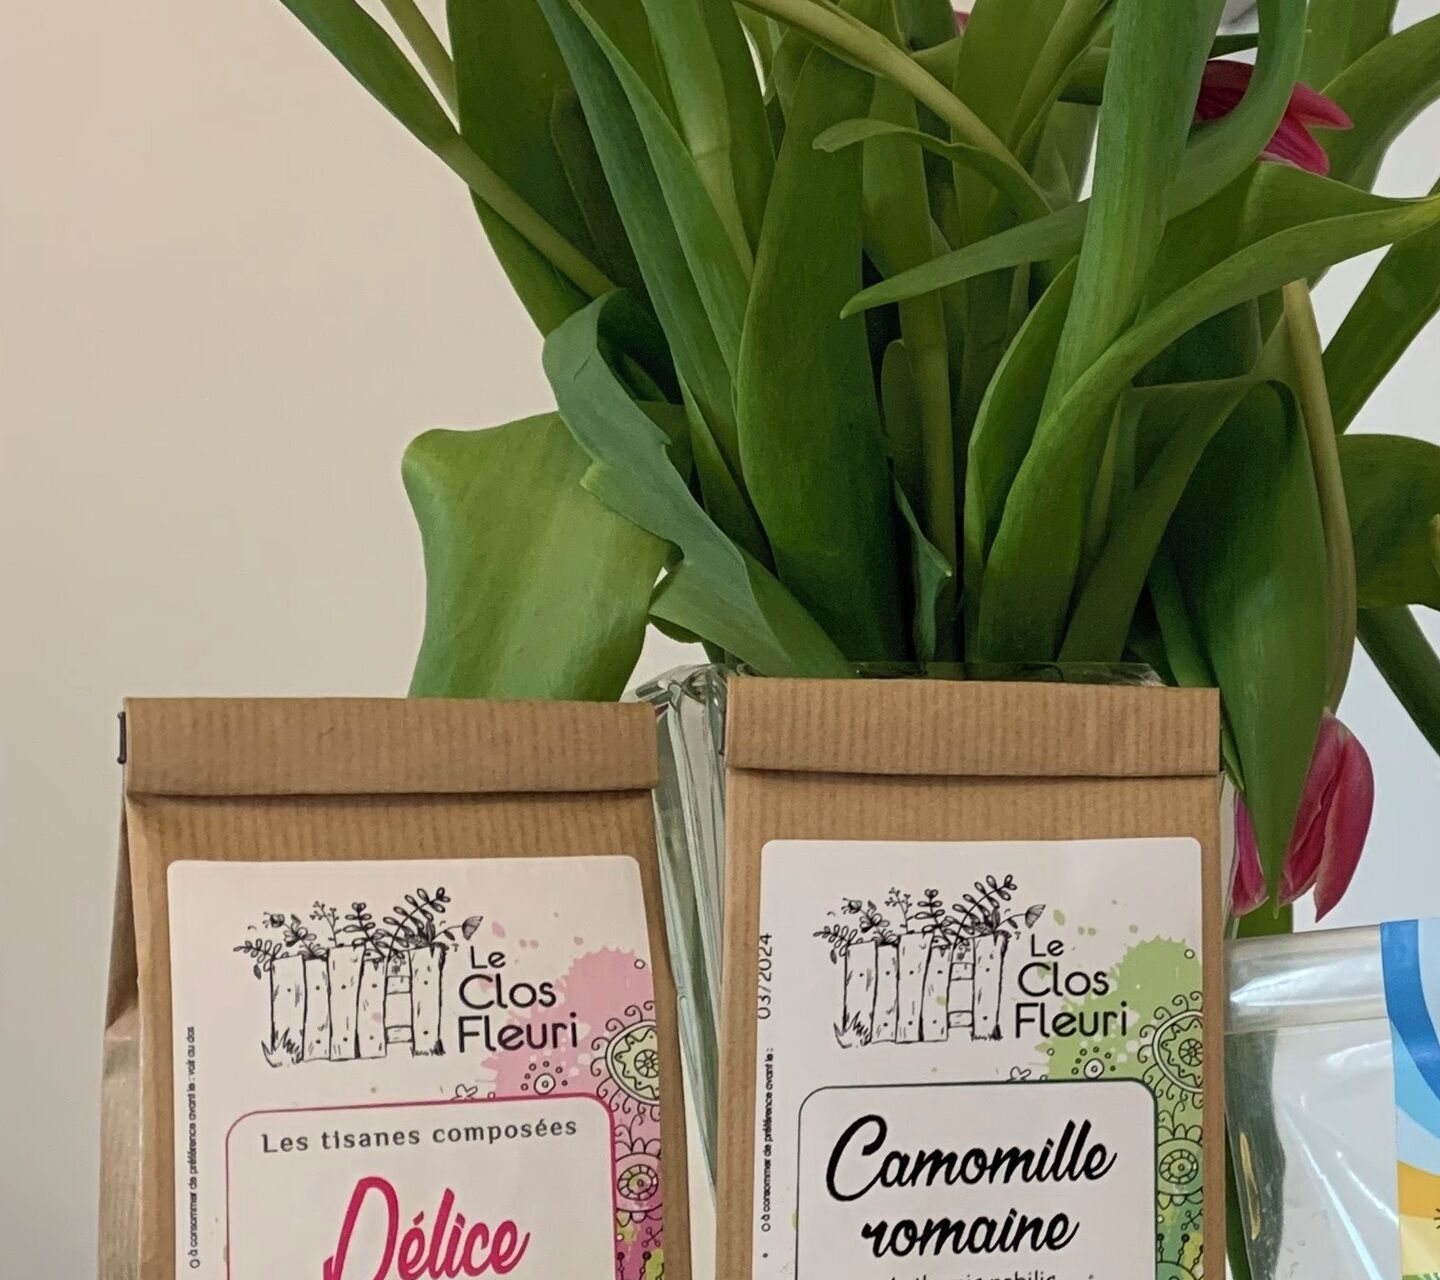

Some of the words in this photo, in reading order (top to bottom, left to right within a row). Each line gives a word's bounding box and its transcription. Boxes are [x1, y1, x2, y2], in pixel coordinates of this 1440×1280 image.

[469, 946, 506, 969] Le
[1031, 934, 1064, 956] Le
[458, 973, 556, 1009] Clos
[1017, 962, 1109, 997] Clos
[457, 1012, 578, 1053] Fleuri
[1015, 1001, 1127, 1038] Fleuri
[262, 1133, 308, 1153] Les
[322, 1127, 420, 1150] tisanes
[432, 1119, 577, 1148] composées
[826, 1114, 1117, 1202] Camomille
[861, 1209, 1079, 1257] romaine
